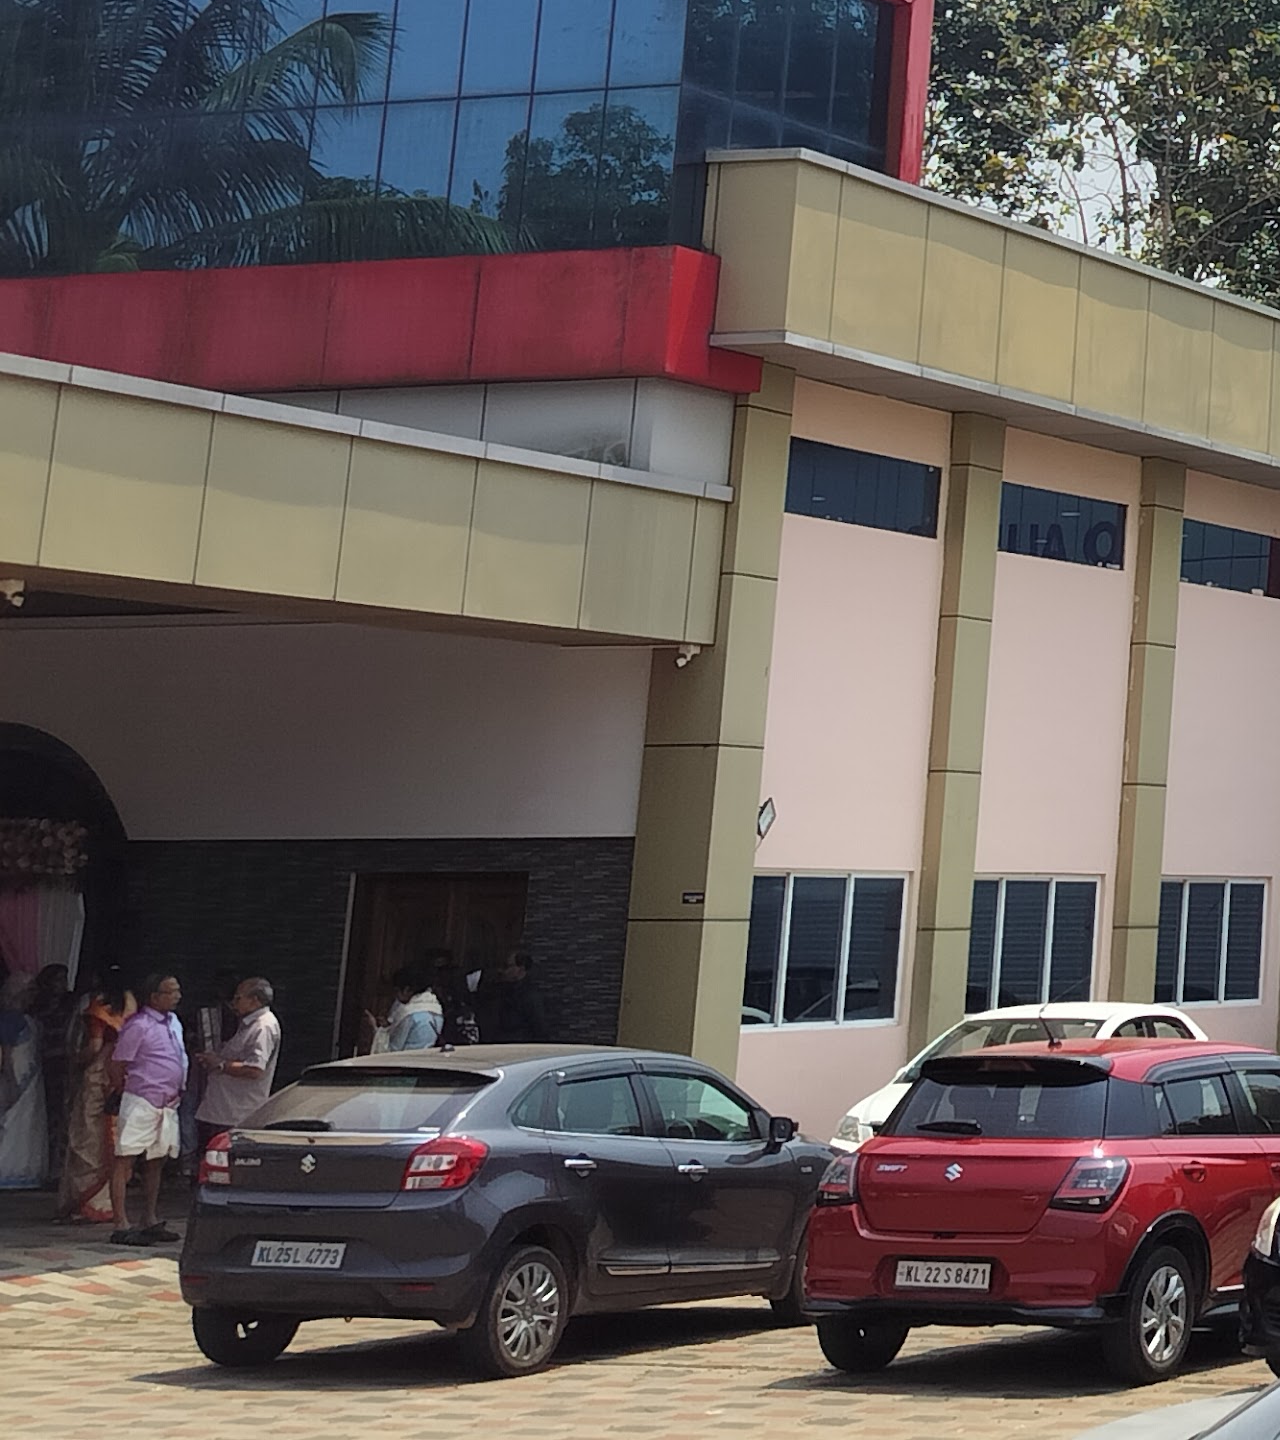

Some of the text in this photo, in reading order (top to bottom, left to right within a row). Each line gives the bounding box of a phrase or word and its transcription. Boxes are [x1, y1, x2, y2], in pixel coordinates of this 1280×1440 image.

[257, 1246, 272, 1264] KL
[274, 1247, 293, 1264] 25
[305, 1248, 340, 1265] 4773
[904, 1265, 987, 1285] KL 22 S 8471
